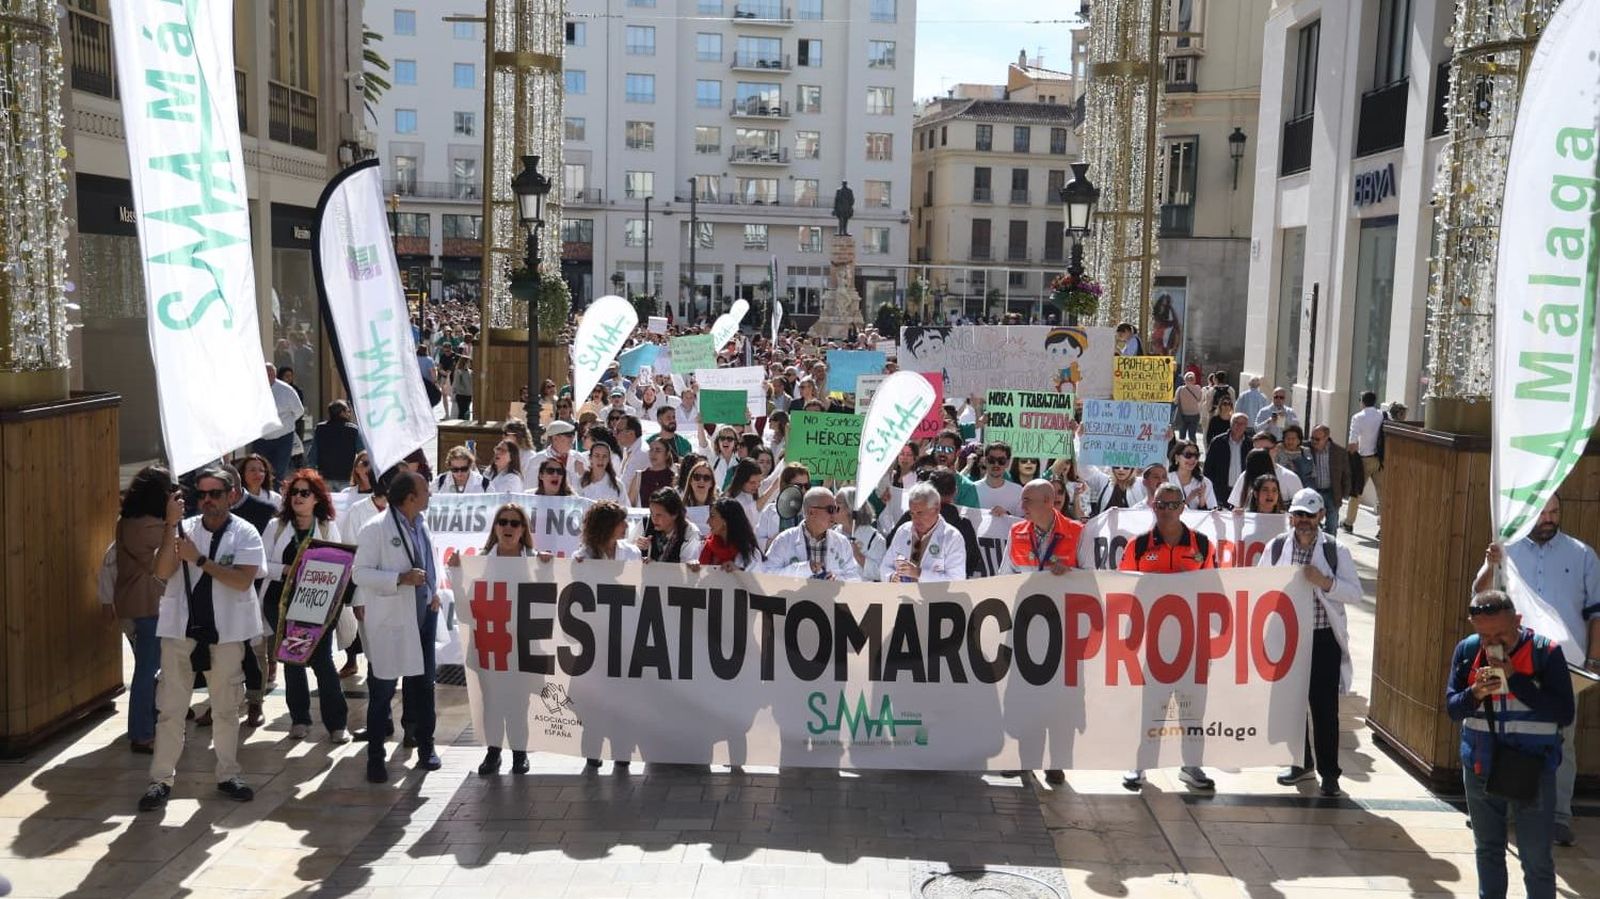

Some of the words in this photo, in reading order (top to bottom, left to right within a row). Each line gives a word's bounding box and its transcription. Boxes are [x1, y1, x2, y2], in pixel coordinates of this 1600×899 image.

[1353, 162, 1396, 207] BBVA
[1514, 126, 1598, 403] Málaga
[577, 316, 625, 373] SMA
[352, 320, 407, 428] SMA
[988, 391, 1014, 407] HORA
[1018, 392, 1071, 409] TRABAJADA
[804, 415, 818, 425] NO
[865, 395, 923, 464] SMA
[987, 411, 1014, 428] HORA
[806, 427, 861, 447] HÉROES
[1137, 423, 1153, 441] 24
[294, 586, 329, 609] MARCO
[469, 579, 1300, 688] #ESTATUTOMARCOPROPIO
[534, 714, 582, 726] ASOCIACIÓN
[806, 689, 898, 741] SMA
[544, 729, 572, 738] ESPAÑA
[550, 723, 563, 731] MIR
